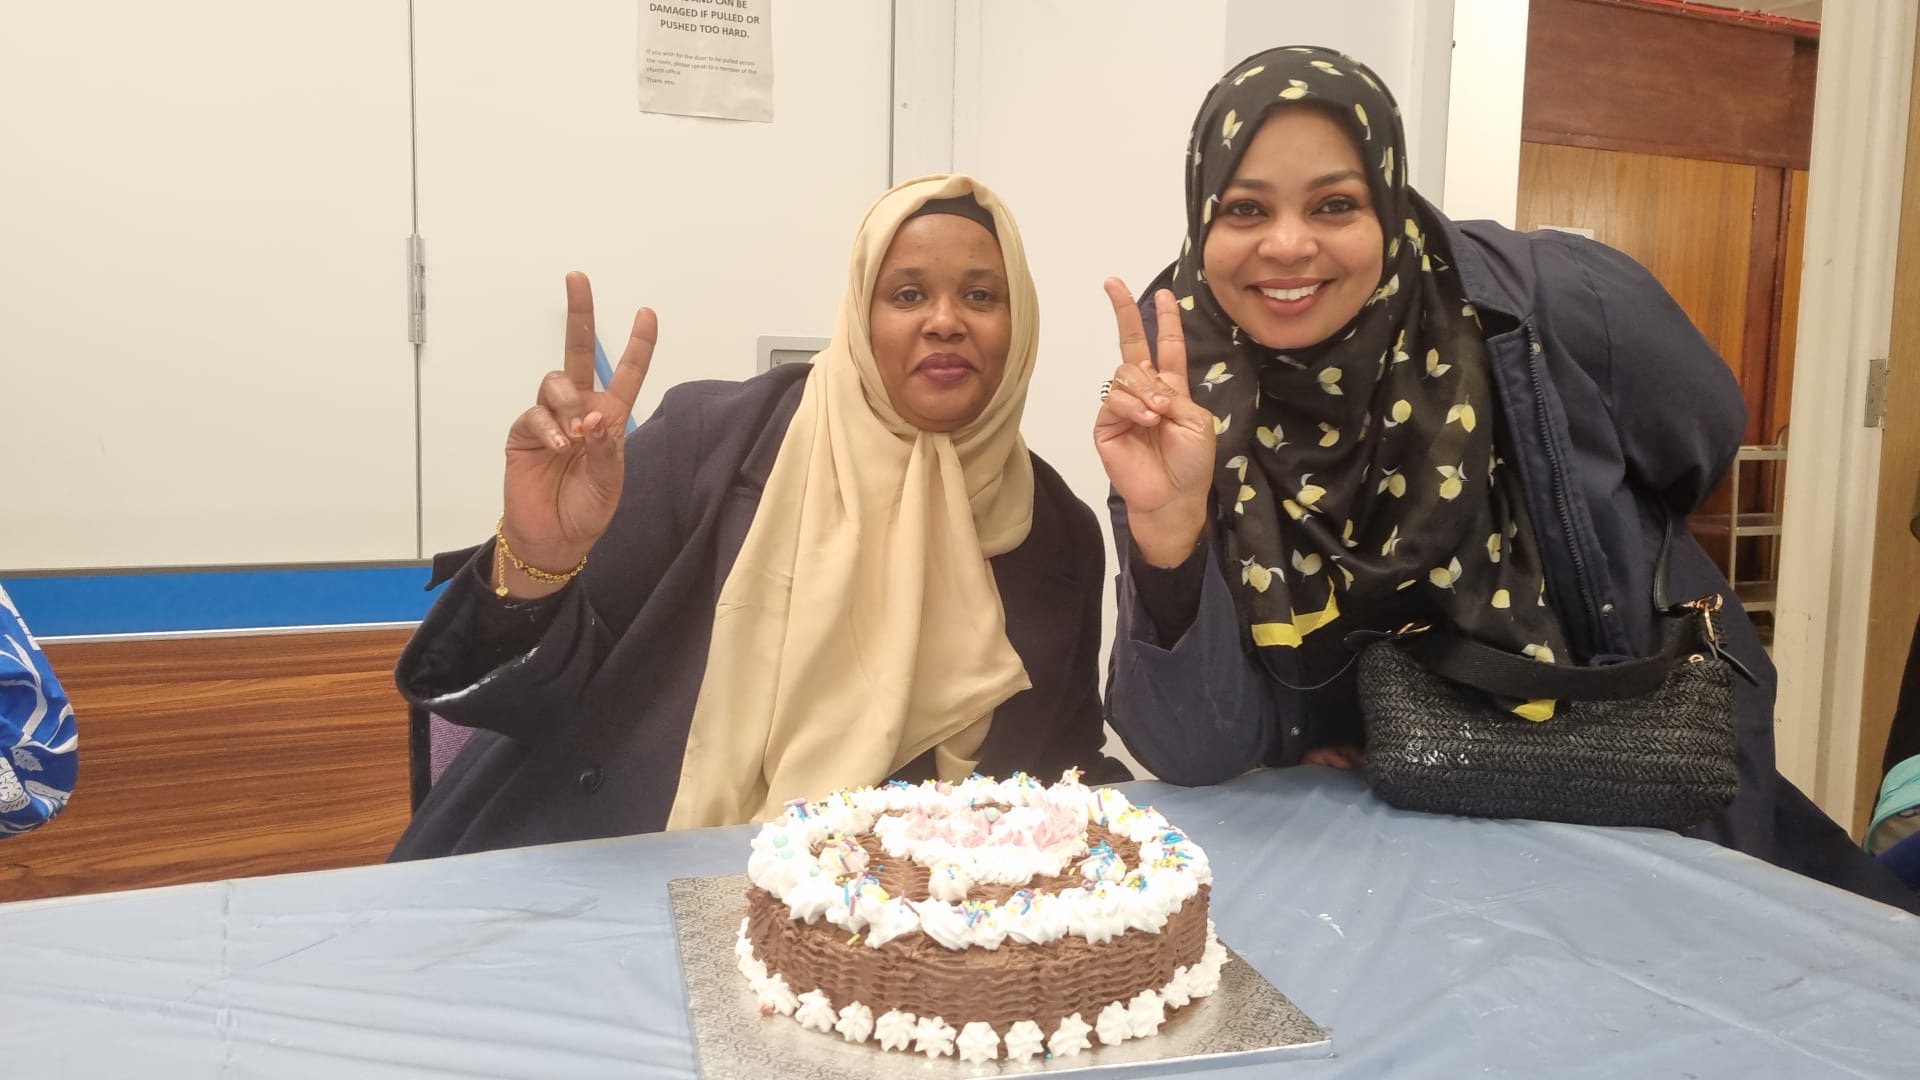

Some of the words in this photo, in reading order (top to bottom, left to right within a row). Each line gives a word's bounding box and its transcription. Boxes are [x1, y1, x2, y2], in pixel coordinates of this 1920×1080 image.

[649, 3, 698, 17] DAMAGED
[700, 10, 708, 18] IF
[711, 10, 744, 22] PULLED
[746, 16, 760, 24] OR
[736, 0, 748, 8] BE
[660, 19, 697, 32] PUSHED
[700, 24, 720, 34] TOO
[722, 26, 750, 38] HARD.
